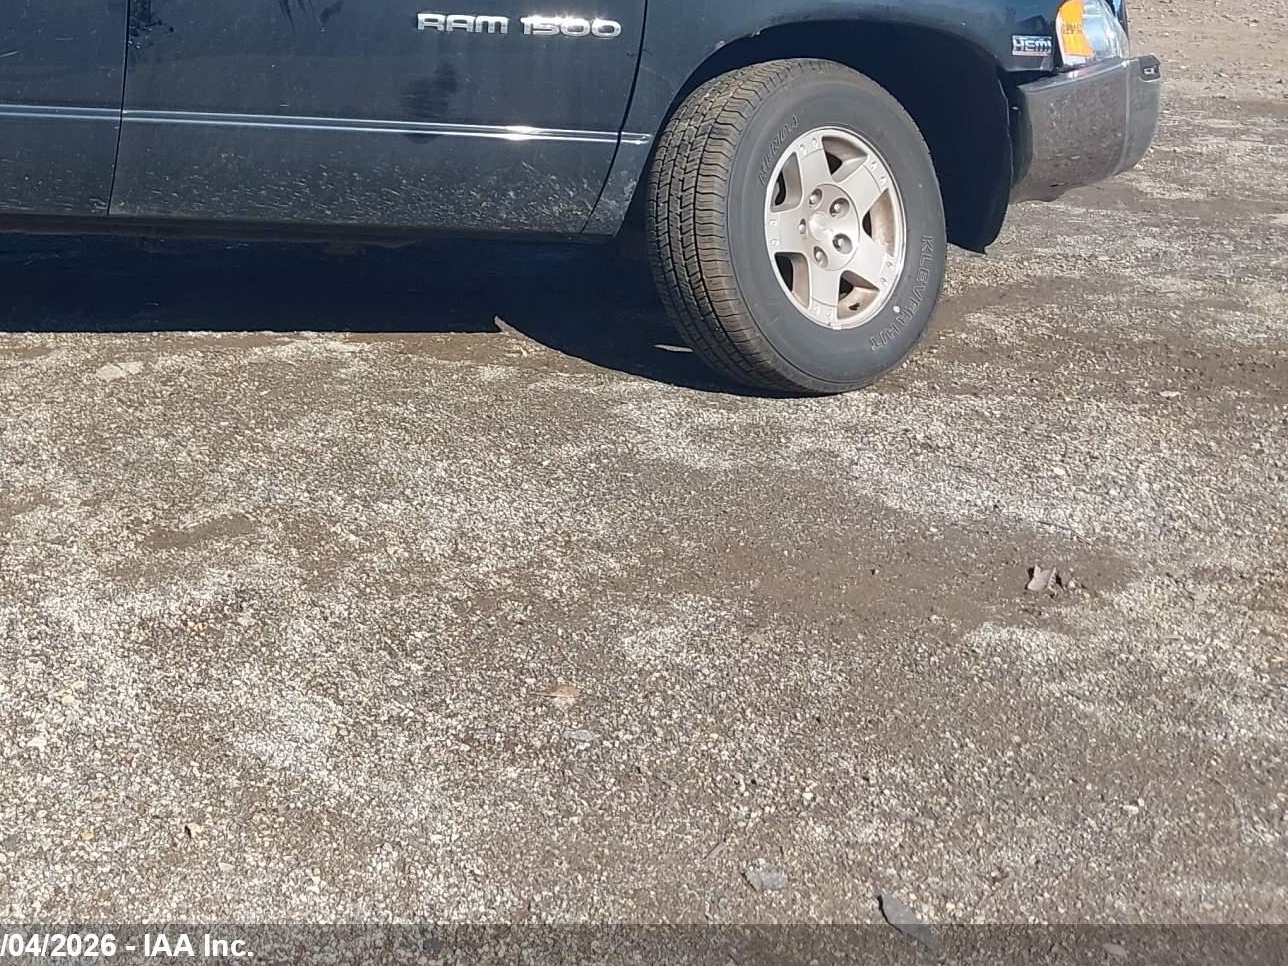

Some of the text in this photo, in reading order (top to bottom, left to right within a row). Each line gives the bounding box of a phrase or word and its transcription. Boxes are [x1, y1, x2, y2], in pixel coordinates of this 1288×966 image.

[417, 13, 622, 38] RAM 1500
[1012, 36, 1052, 53] HEMI
[868, 234, 936, 352] KLEVER H/T
